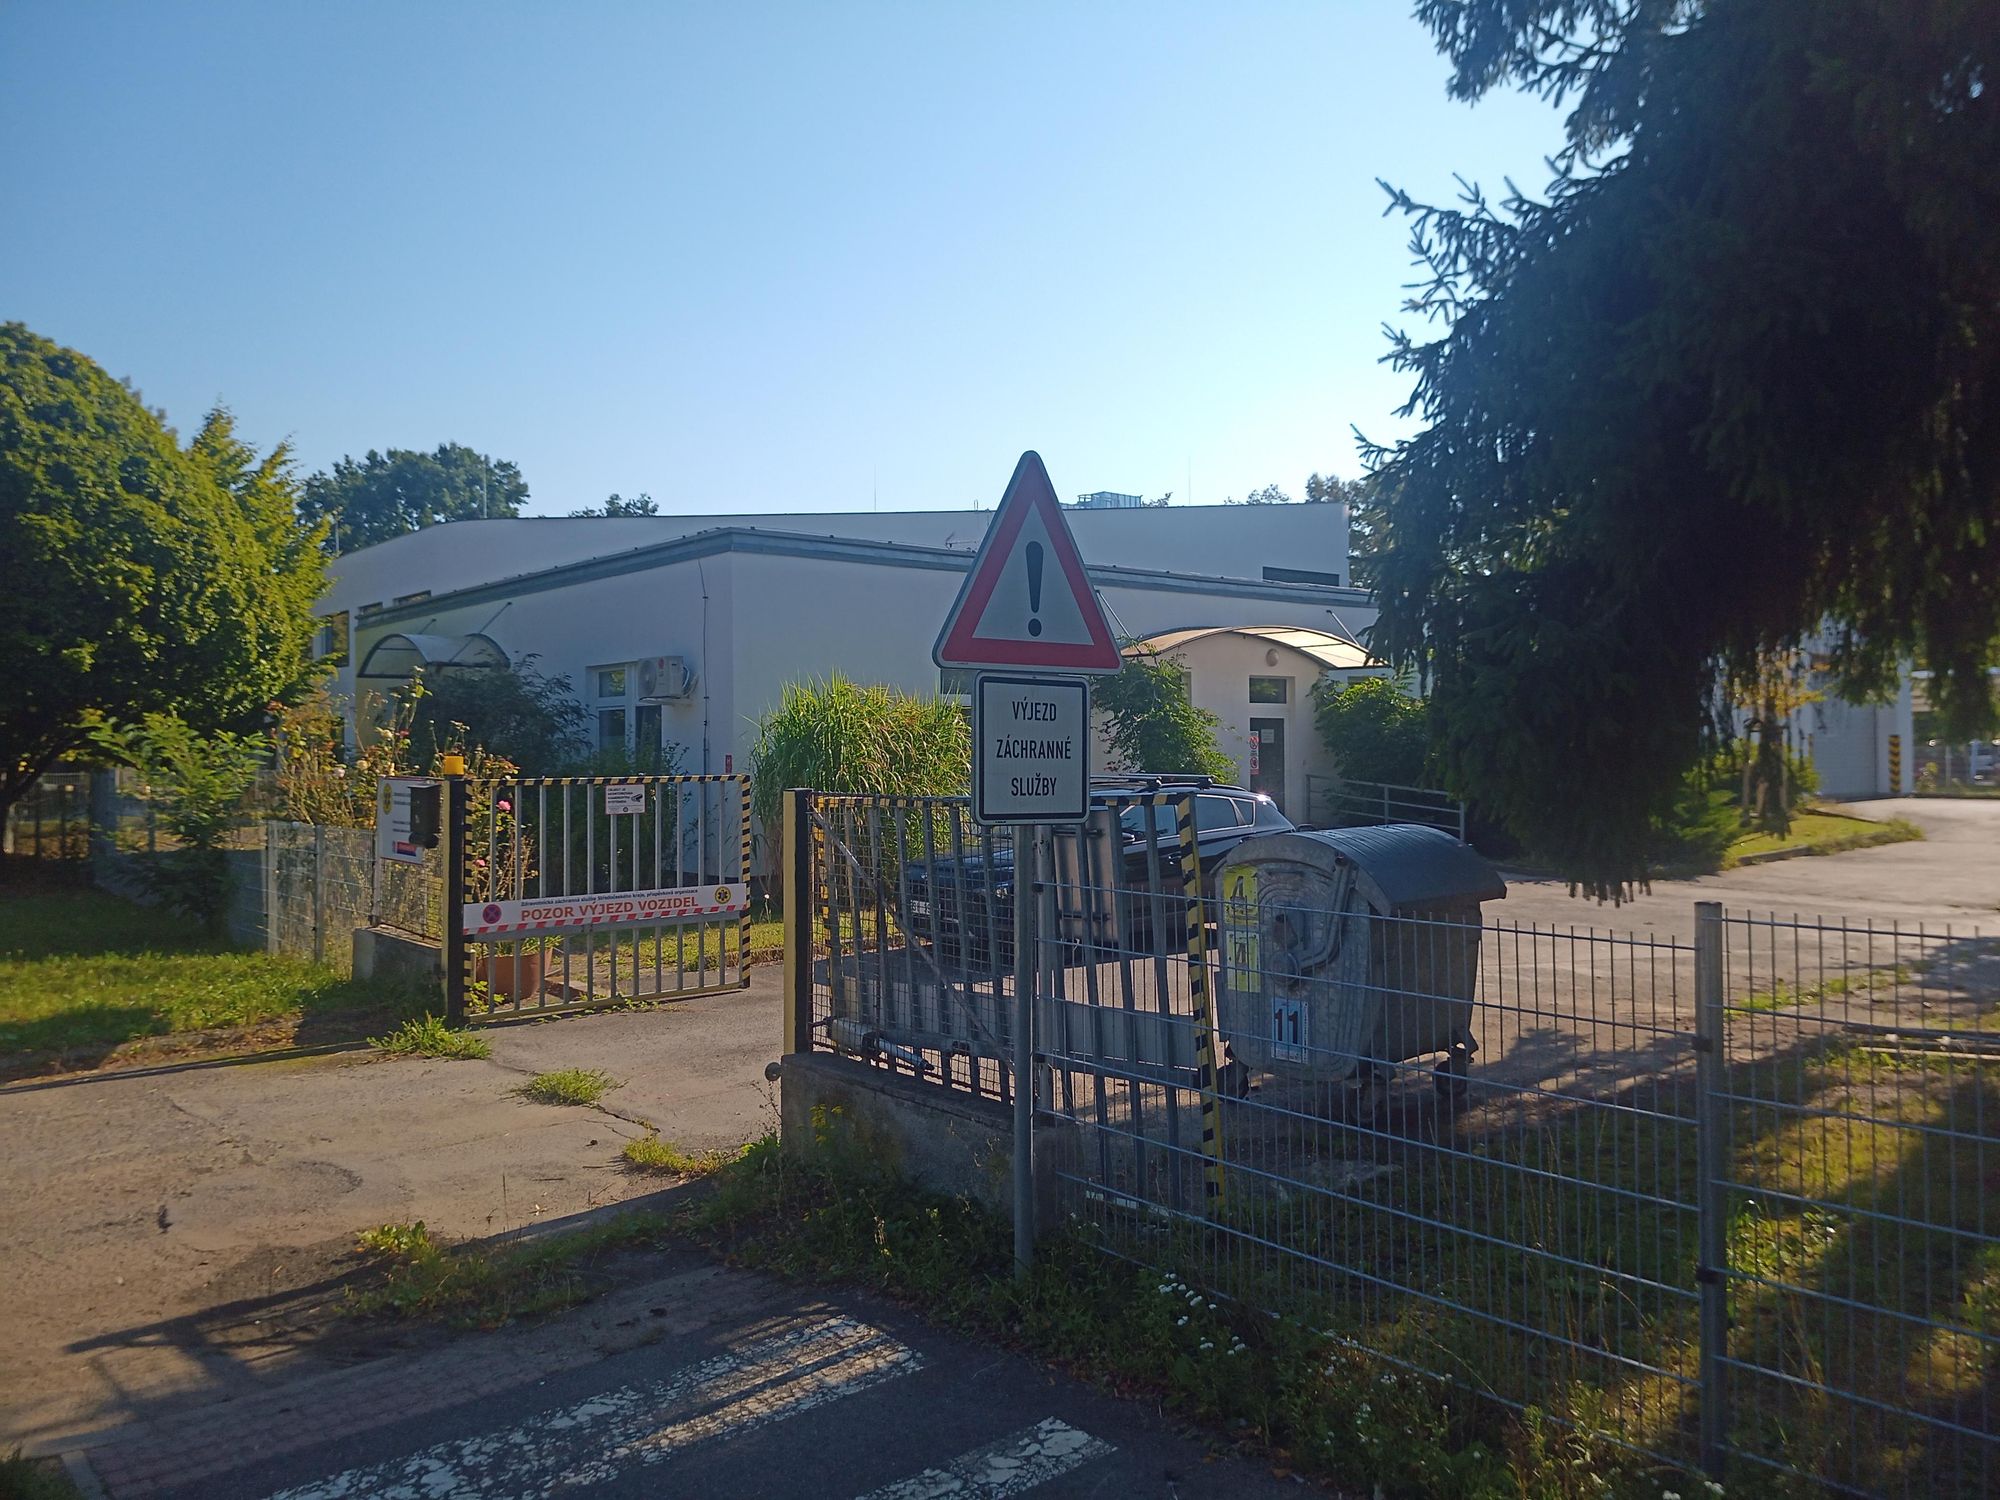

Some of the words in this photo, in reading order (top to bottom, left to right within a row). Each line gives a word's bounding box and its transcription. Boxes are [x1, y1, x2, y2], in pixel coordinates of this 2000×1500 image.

[1012, 696, 1057, 721] VÝJEZD
[996, 734, 1071, 759] ZÁCHRANNÉ
[1011, 772, 1057, 796] SLUŽBY
[521, 906, 574, 921] POZOR
[579, 901, 633, 916] VÝJEZD
[638, 896, 698, 911] VOZIDEL
[1275, 1008, 1298, 1045] 11
